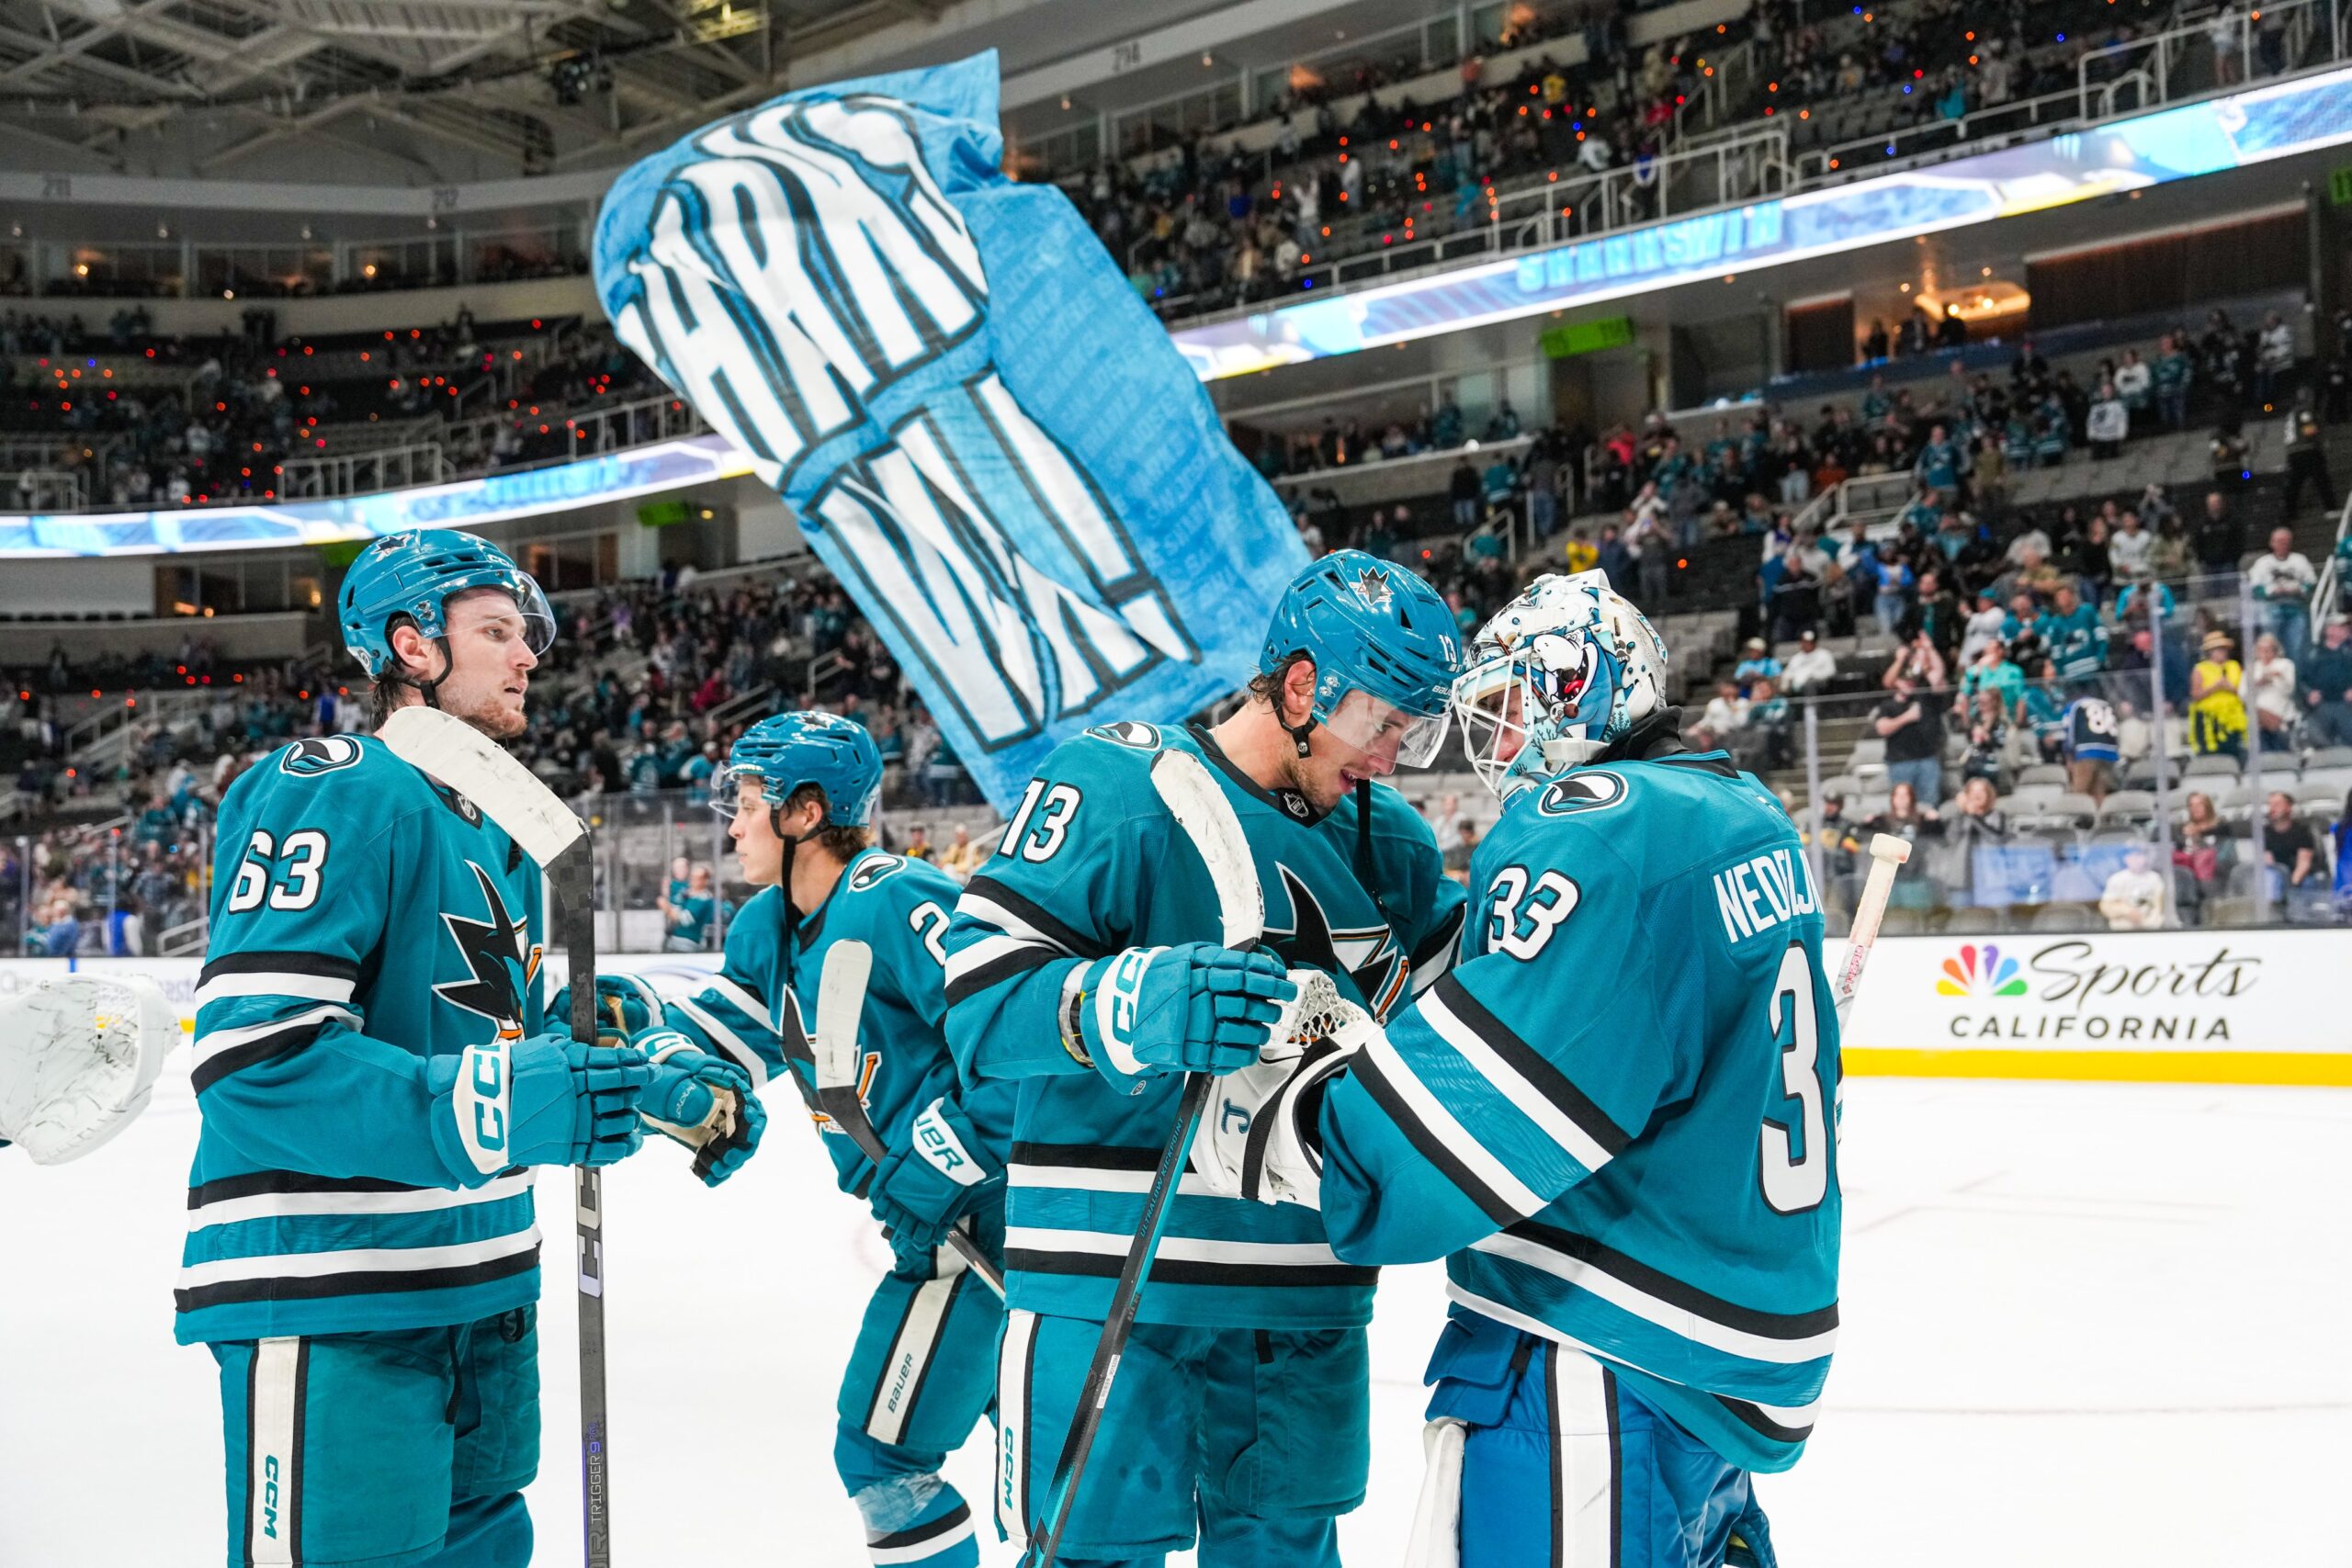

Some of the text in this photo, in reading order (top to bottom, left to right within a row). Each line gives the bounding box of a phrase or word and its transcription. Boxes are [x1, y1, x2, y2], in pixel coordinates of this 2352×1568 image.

[1439, 633, 1457, 663] 13
[997, 777, 1083, 864] 13
[228, 828, 330, 915] 63
[1486, 863, 1582, 964] 33
[1113, 948, 1152, 1046] CC
[2030, 942, 2262, 1011] Sports
[1950, 1015, 2231, 1041] CALIFORNIA
[473, 1045, 505, 1152] CC
[1758, 940, 1841, 1216] 3
[915, 1114, 965, 1171] UER
[576, 1166, 604, 1299] CC
[888, 1352, 914, 1414] BAUER
[589, 1441, 602, 1454] 9
[1004, 1426, 1014, 1511] CCM
[264, 1454, 278, 1540] CCM
[590, 1455, 603, 1526] TRIGGER
